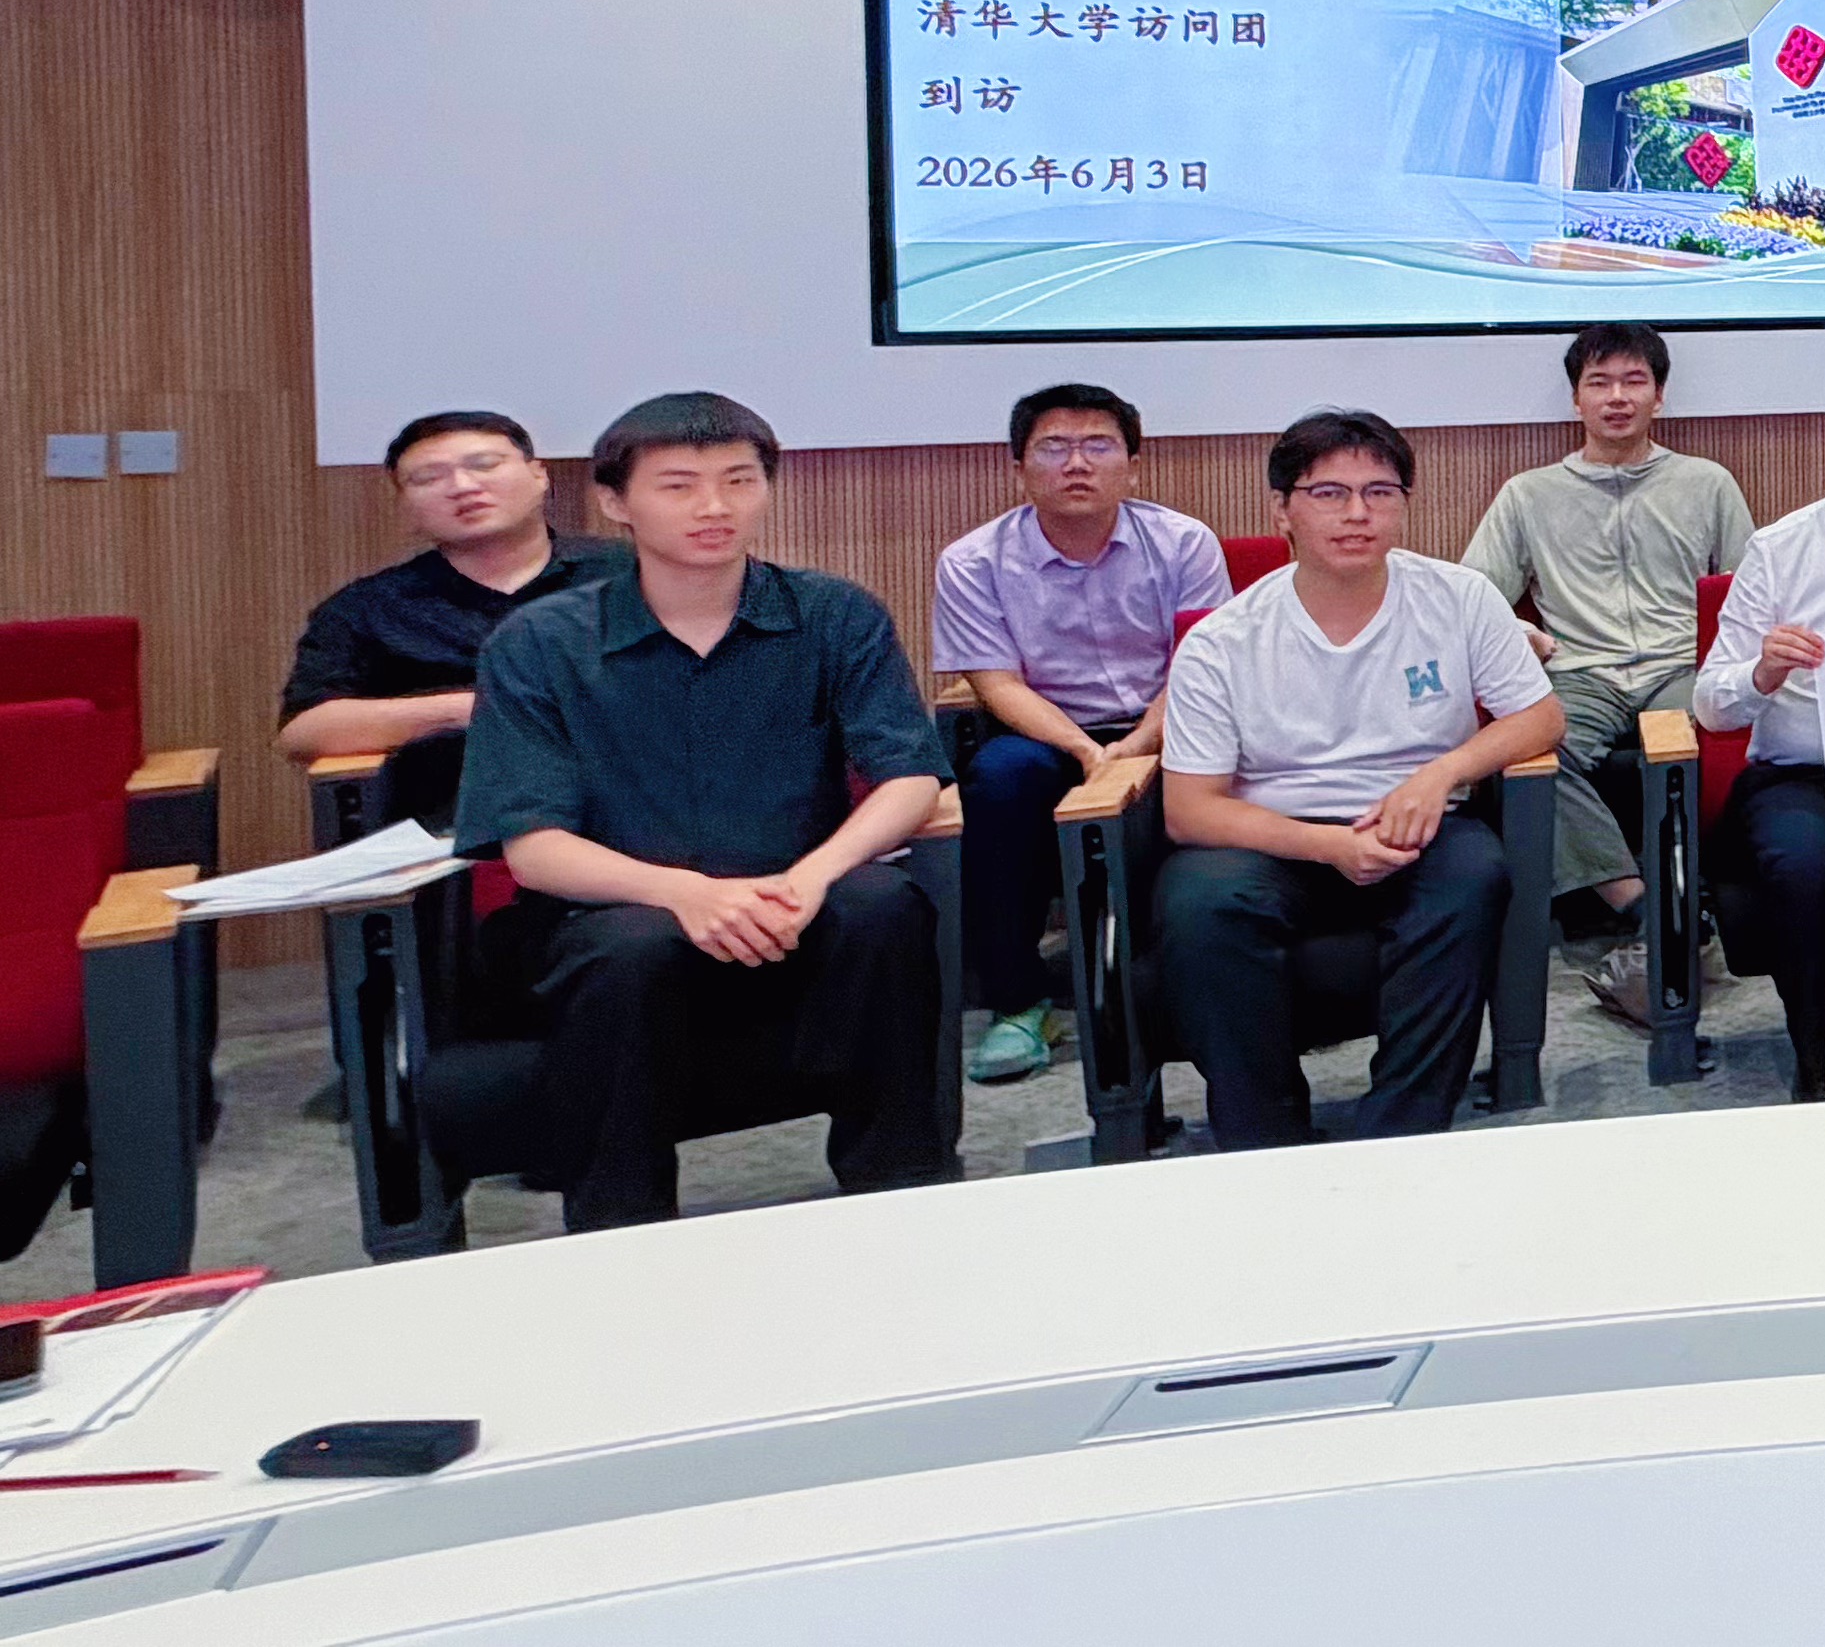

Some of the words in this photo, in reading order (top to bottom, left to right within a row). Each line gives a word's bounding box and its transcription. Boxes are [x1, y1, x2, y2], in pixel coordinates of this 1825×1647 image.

[918, 76, 1022, 114] 到访
[915, 154, 1207, 195] 2026年6月3日
